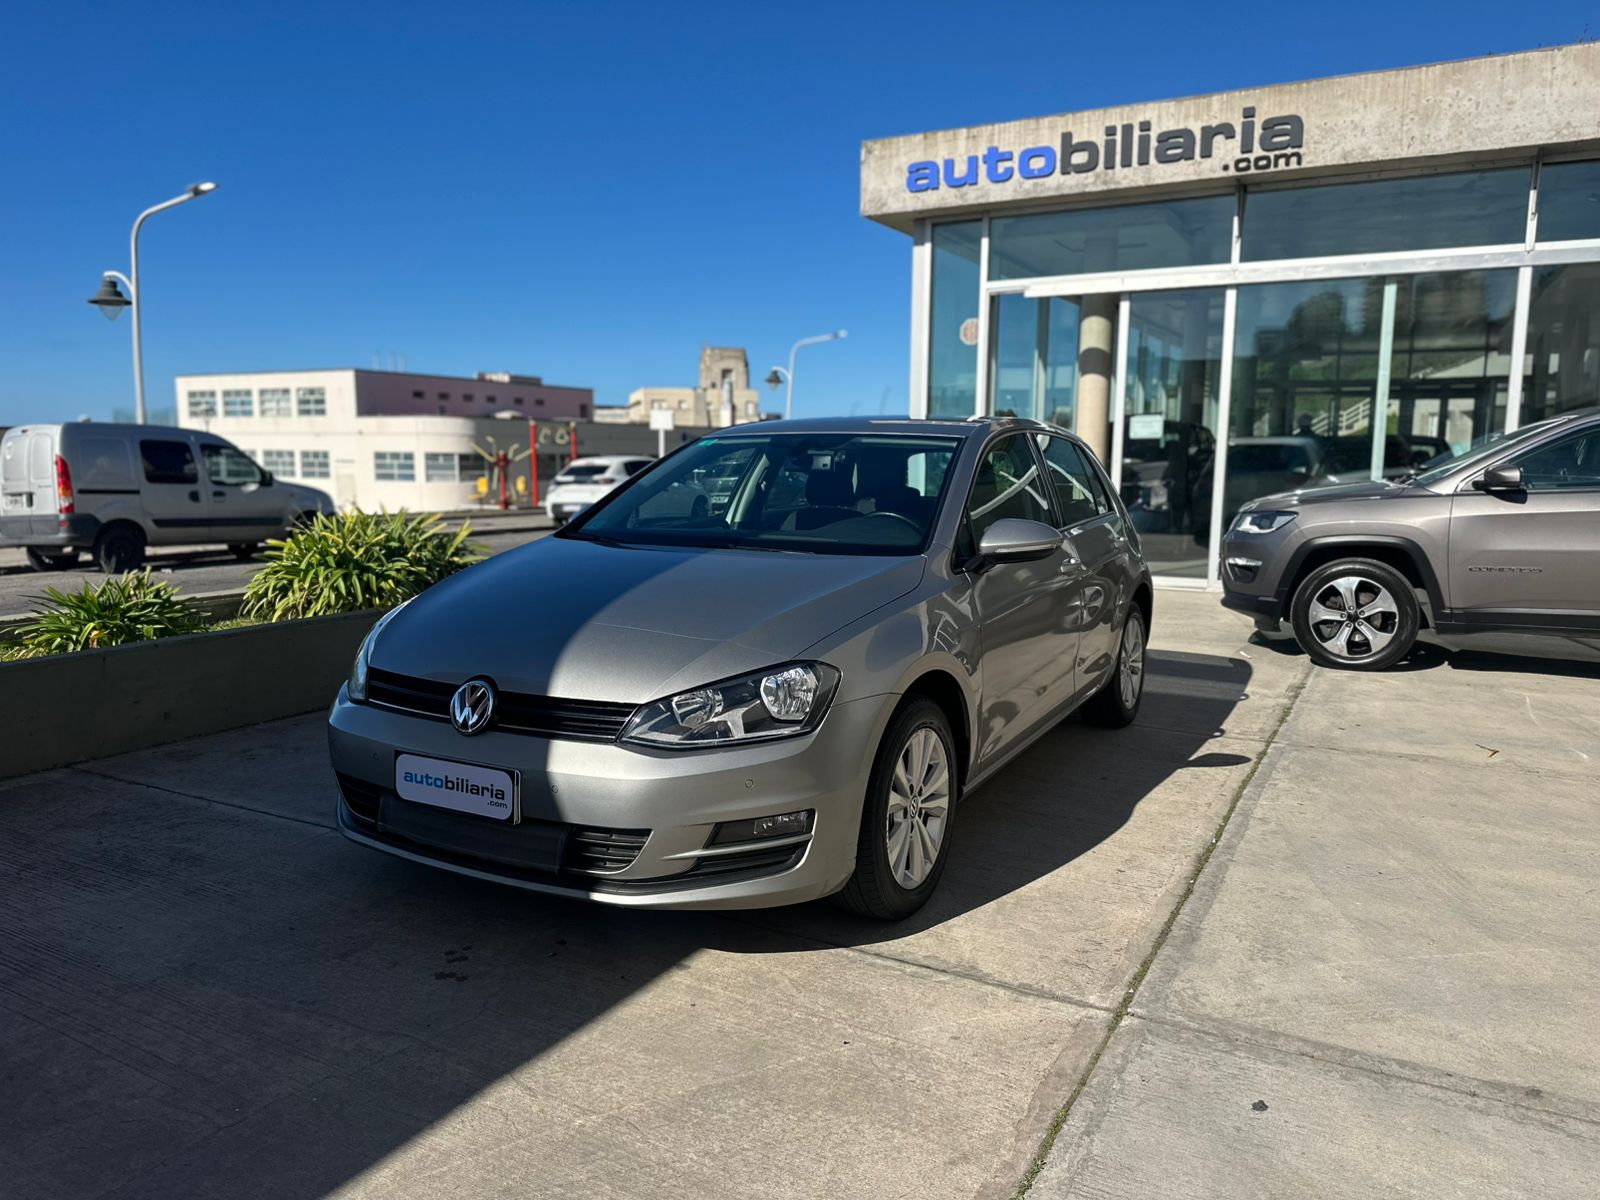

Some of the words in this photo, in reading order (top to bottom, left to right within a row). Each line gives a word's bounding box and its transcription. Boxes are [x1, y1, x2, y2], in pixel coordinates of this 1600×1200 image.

[906, 106, 1304, 193] autobiliaria
[1222, 152, 1302, 172] .com
[403, 771, 505, 800] autobiliaria
[487, 800, 507, 809] .com
